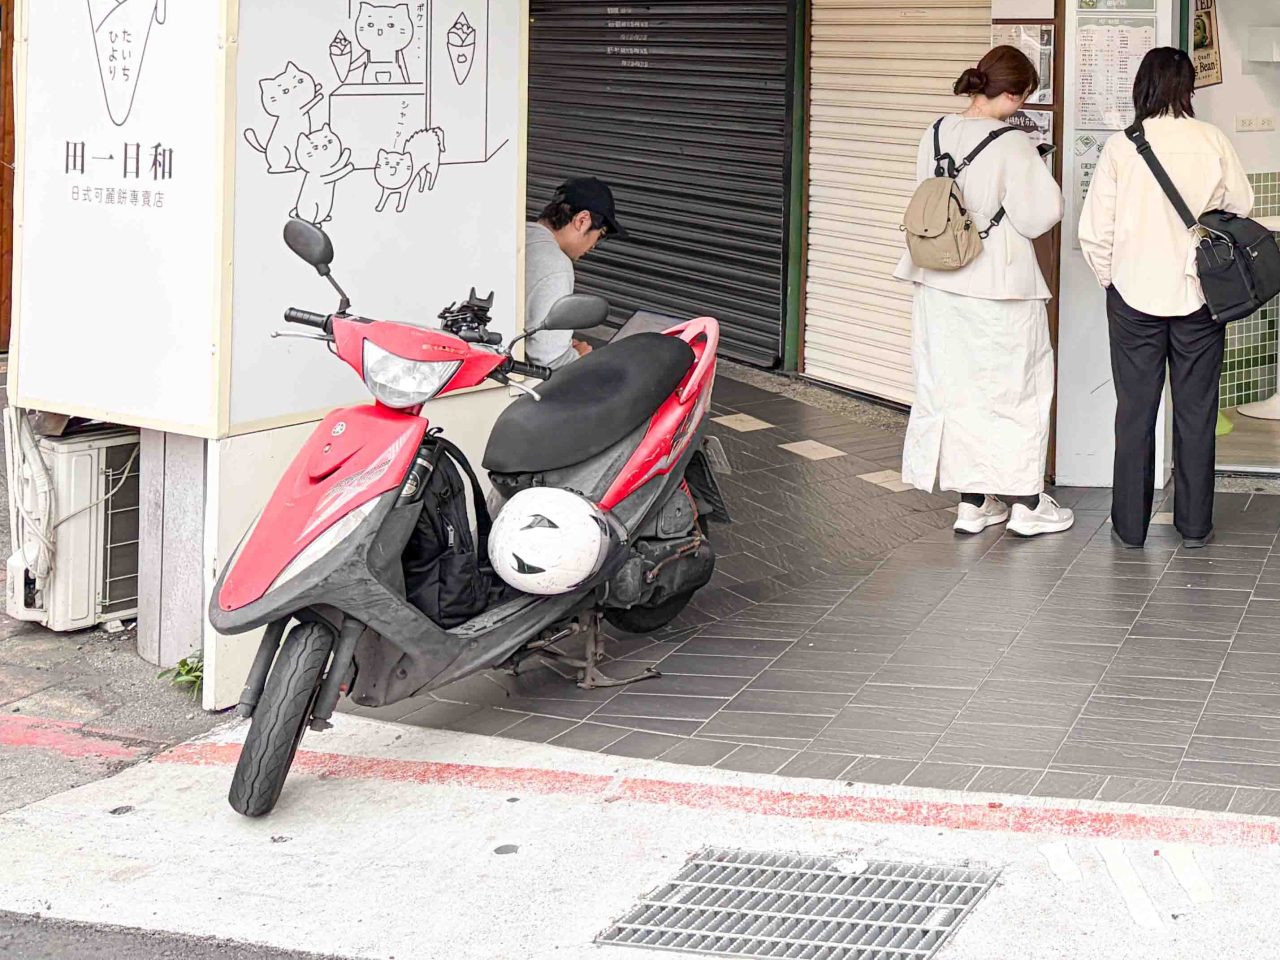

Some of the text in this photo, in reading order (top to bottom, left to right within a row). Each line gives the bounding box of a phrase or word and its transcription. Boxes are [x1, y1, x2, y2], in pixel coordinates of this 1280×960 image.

[1200, 61, 1216, 73] Bean
[65, 141, 173, 180] 田一日和
[71, 185, 164, 208] 日式可麗餅專賣店
